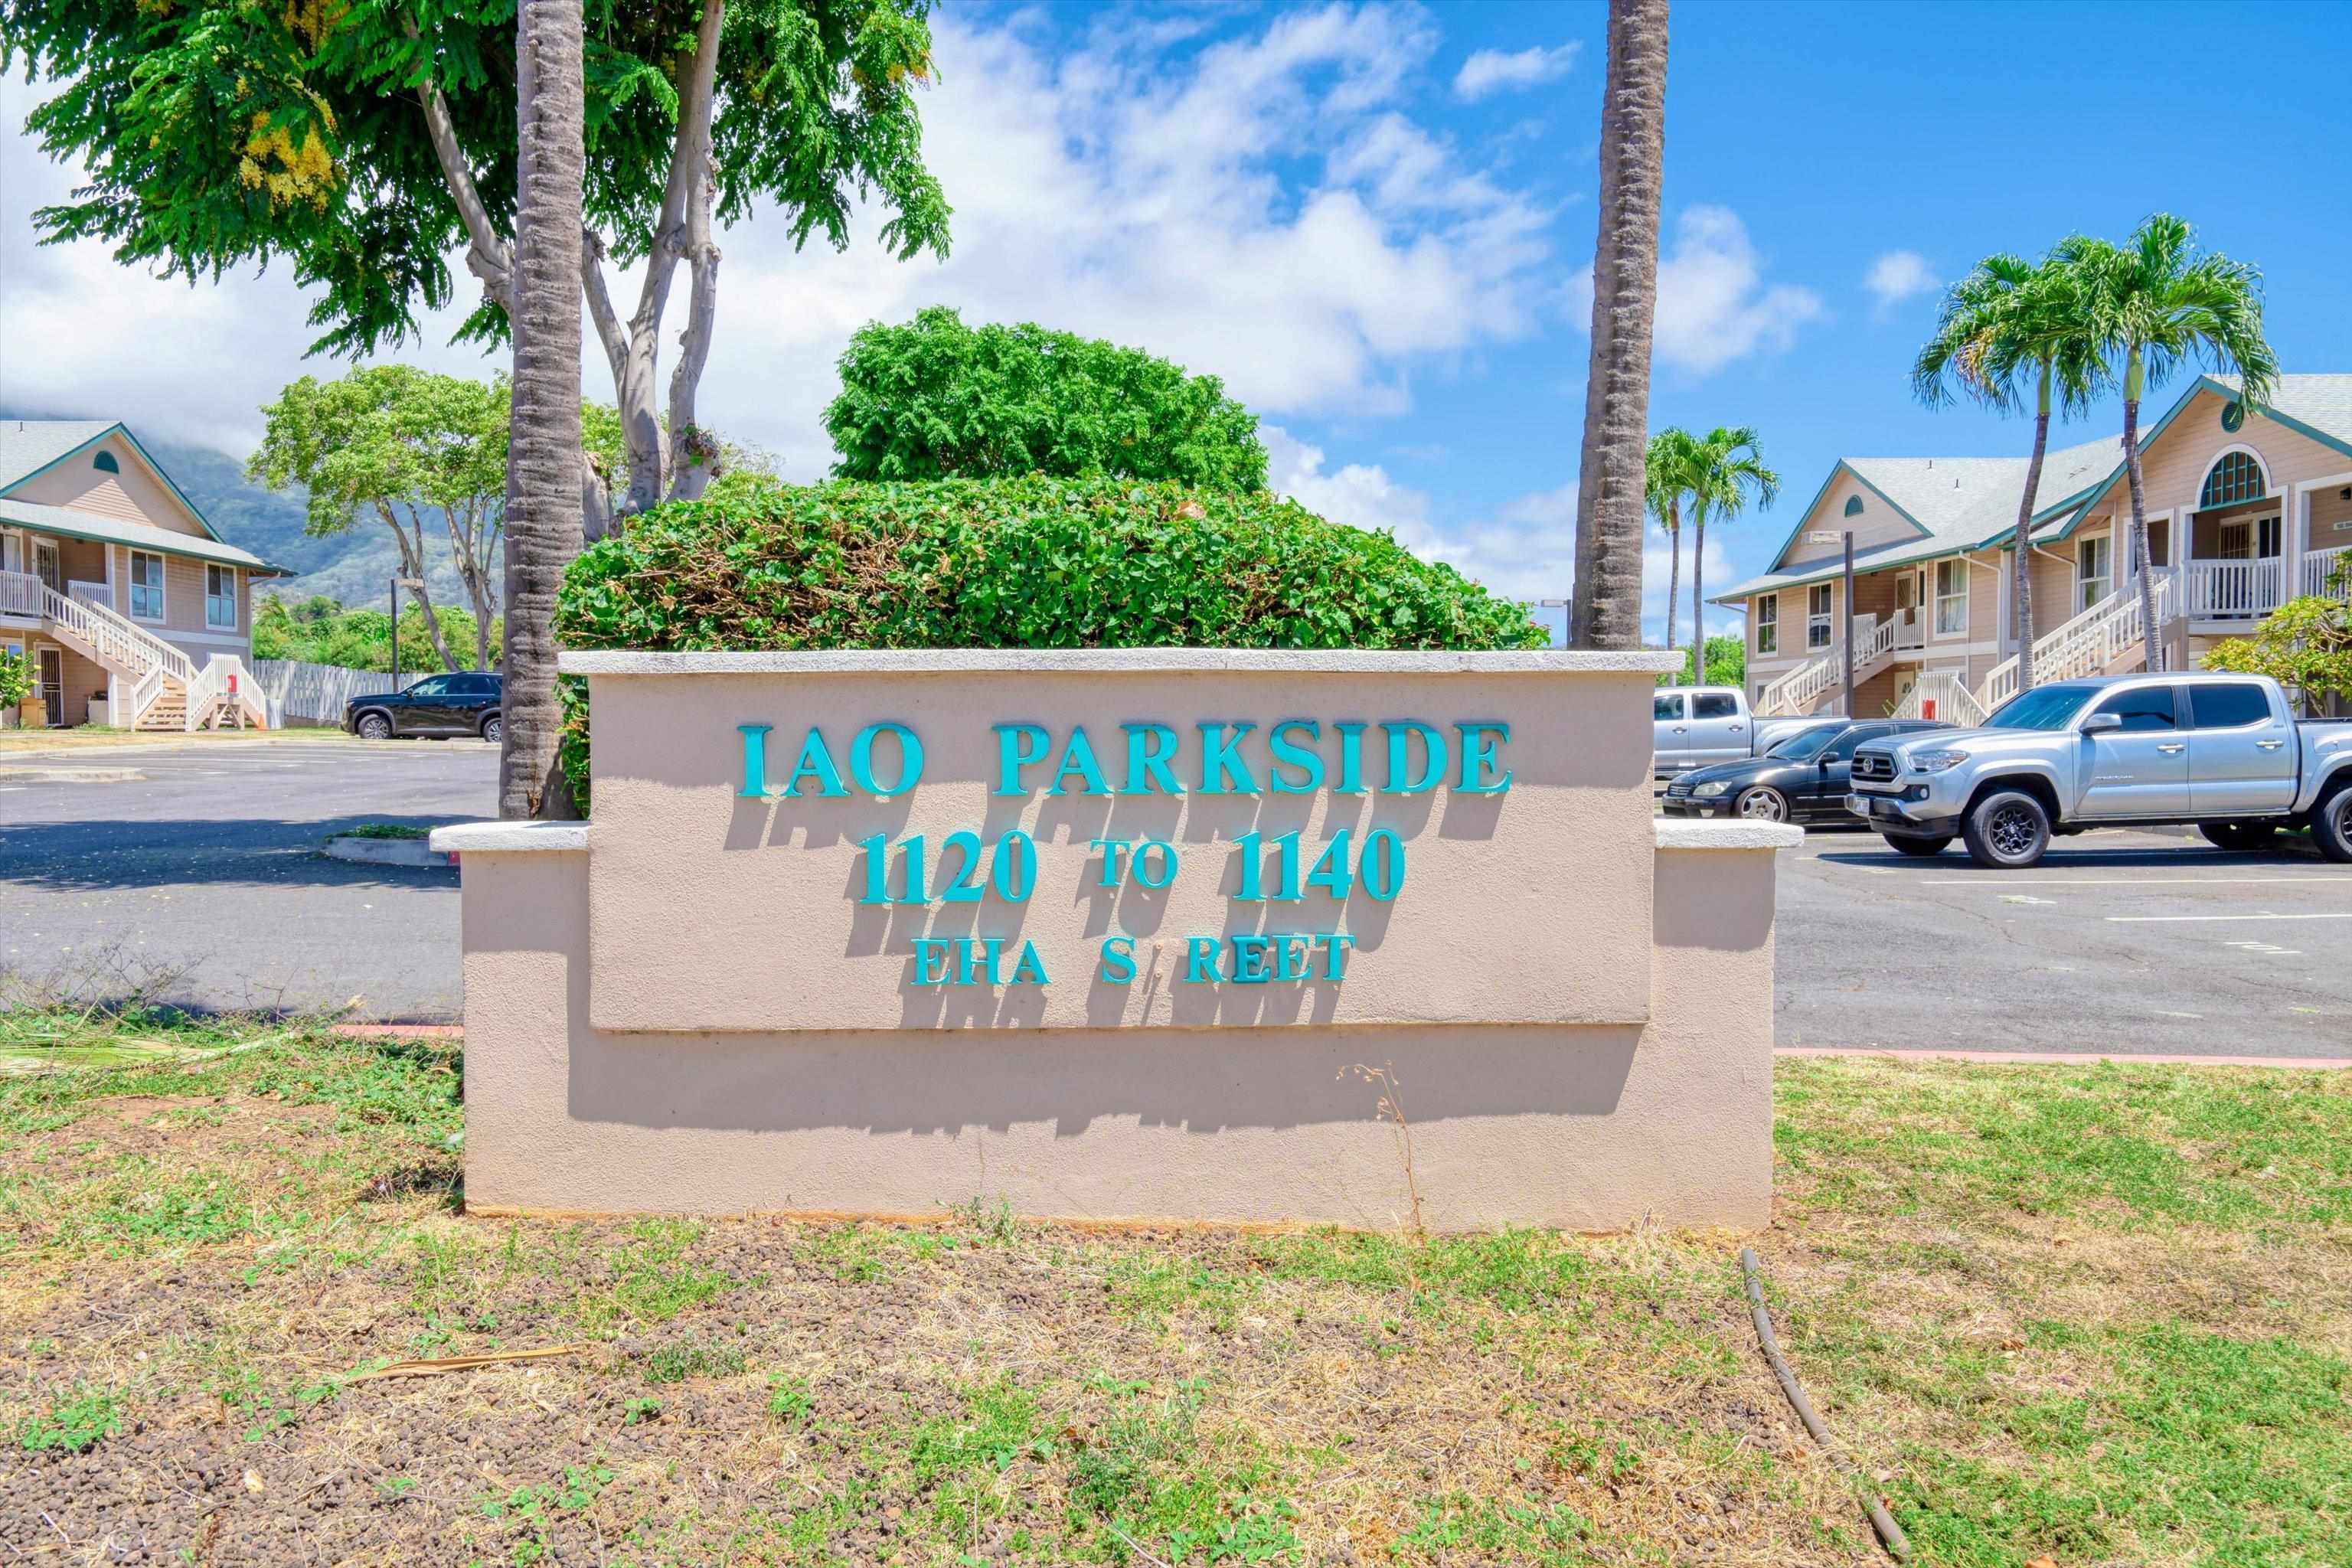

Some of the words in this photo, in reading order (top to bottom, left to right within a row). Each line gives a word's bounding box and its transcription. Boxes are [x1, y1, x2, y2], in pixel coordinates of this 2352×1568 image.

[735, 720, 926, 798] IAO
[991, 718, 1514, 797] PARKSIDE
[857, 828, 1038, 906] 1120
[1090, 838, 1179, 890] TO
[1233, 827, 1406, 902] 1140
[912, 936, 1050, 986] EHA
